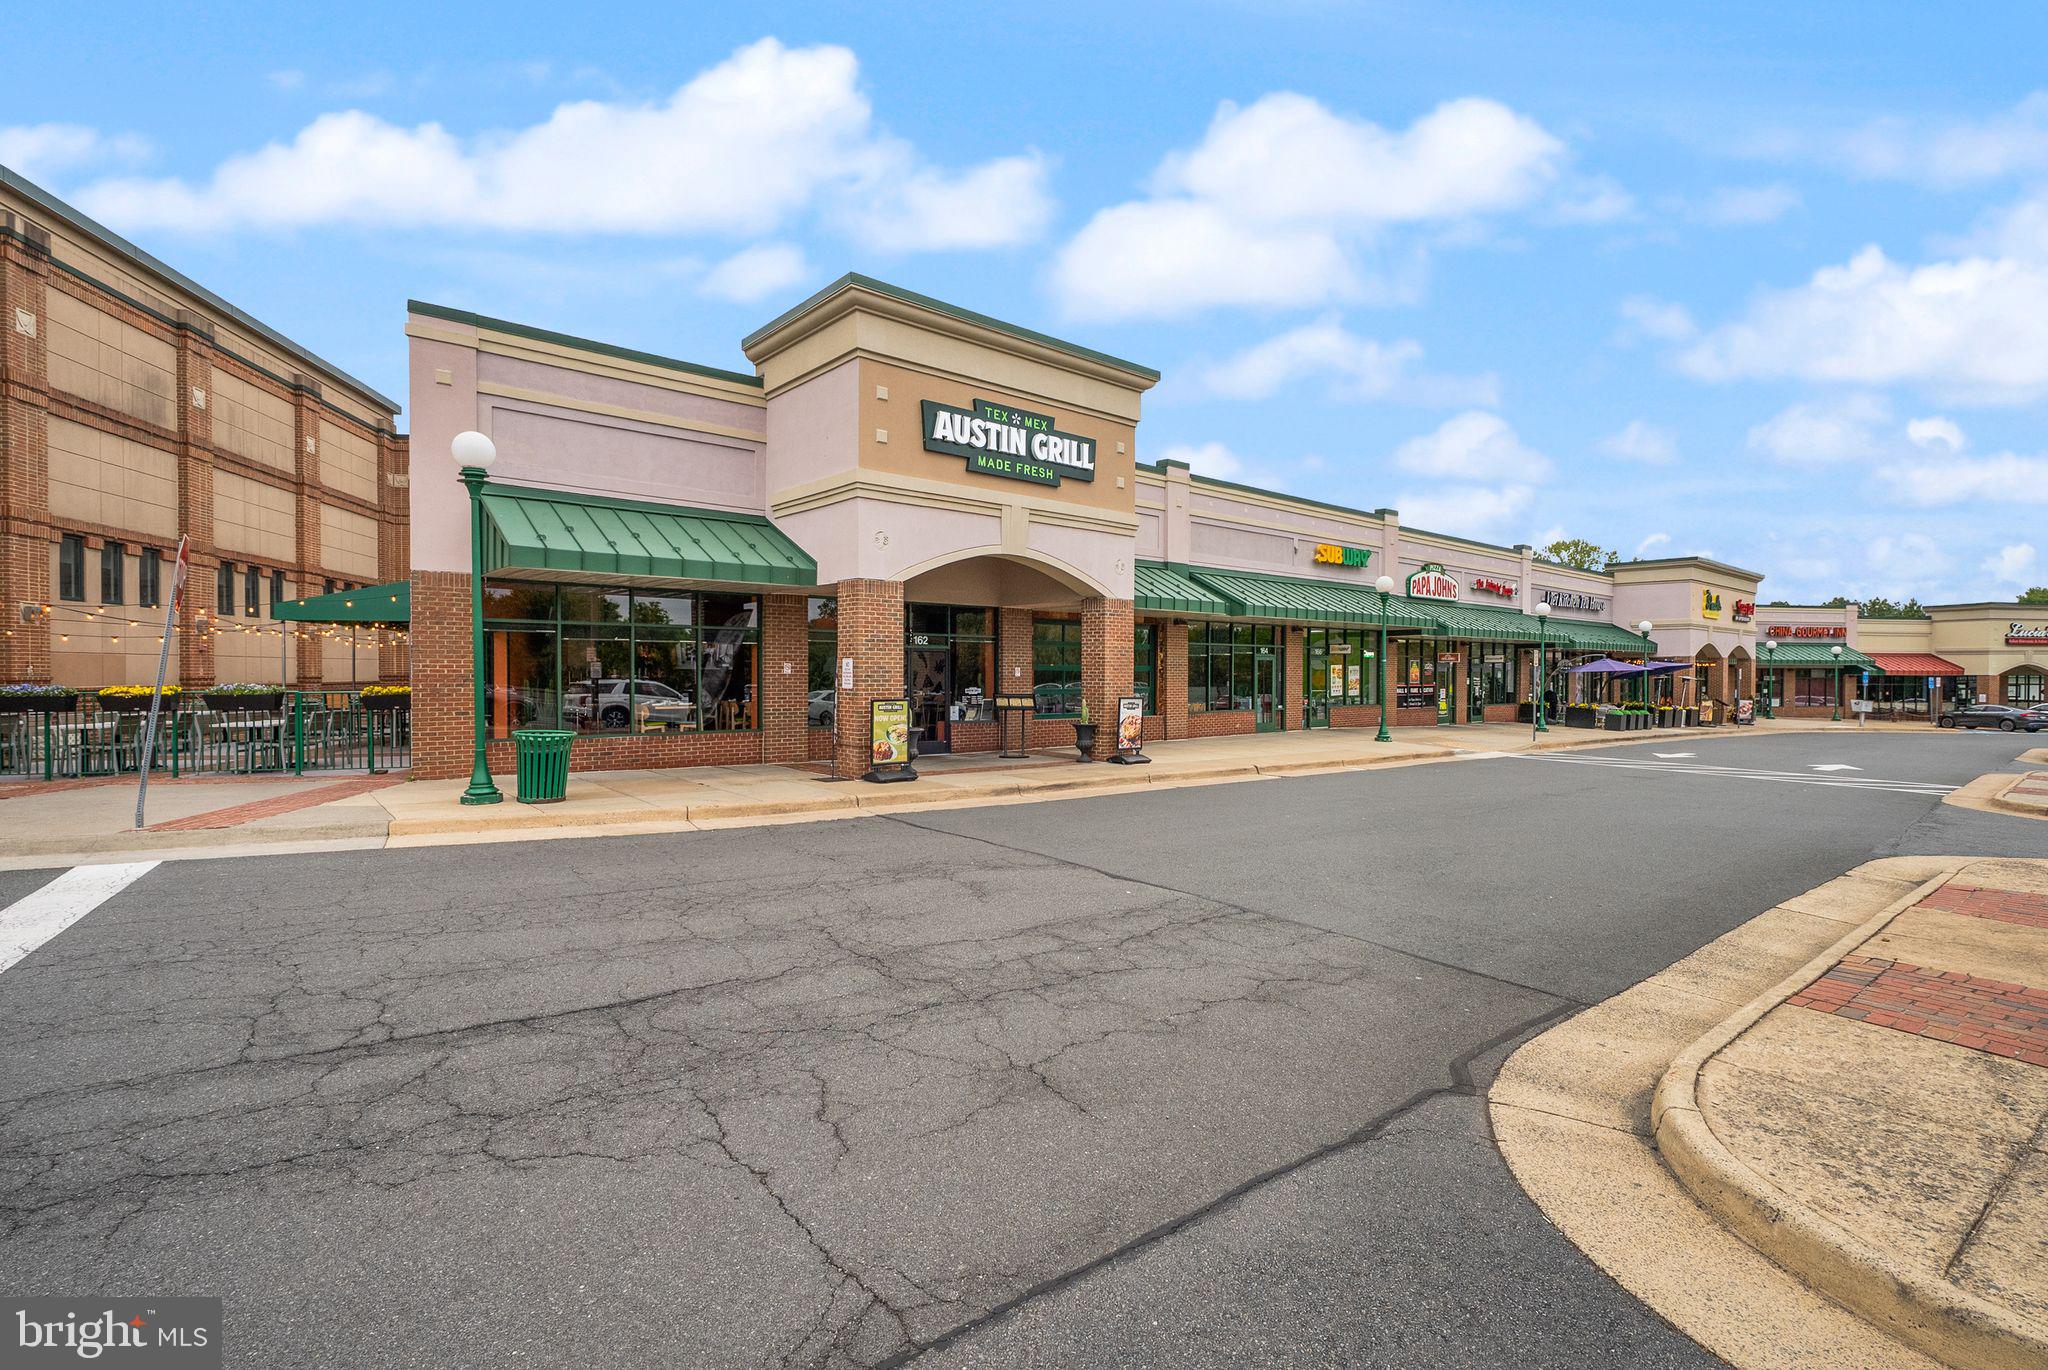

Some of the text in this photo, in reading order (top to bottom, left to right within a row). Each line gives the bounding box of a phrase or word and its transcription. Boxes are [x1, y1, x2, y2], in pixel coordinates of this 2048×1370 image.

[984, 406, 1048, 431] TEX MEX
[932, 410, 1094, 471] AUSTIN GRILL
[978, 456, 1053, 479] MADE FRESH
[1315, 544, 1372, 568] SUBWAY
[1412, 576, 1431, 597] PAPA
[914, 635, 928, 645] 162
[1768, 626, 1847, 638] CHINA GOURMET INN
